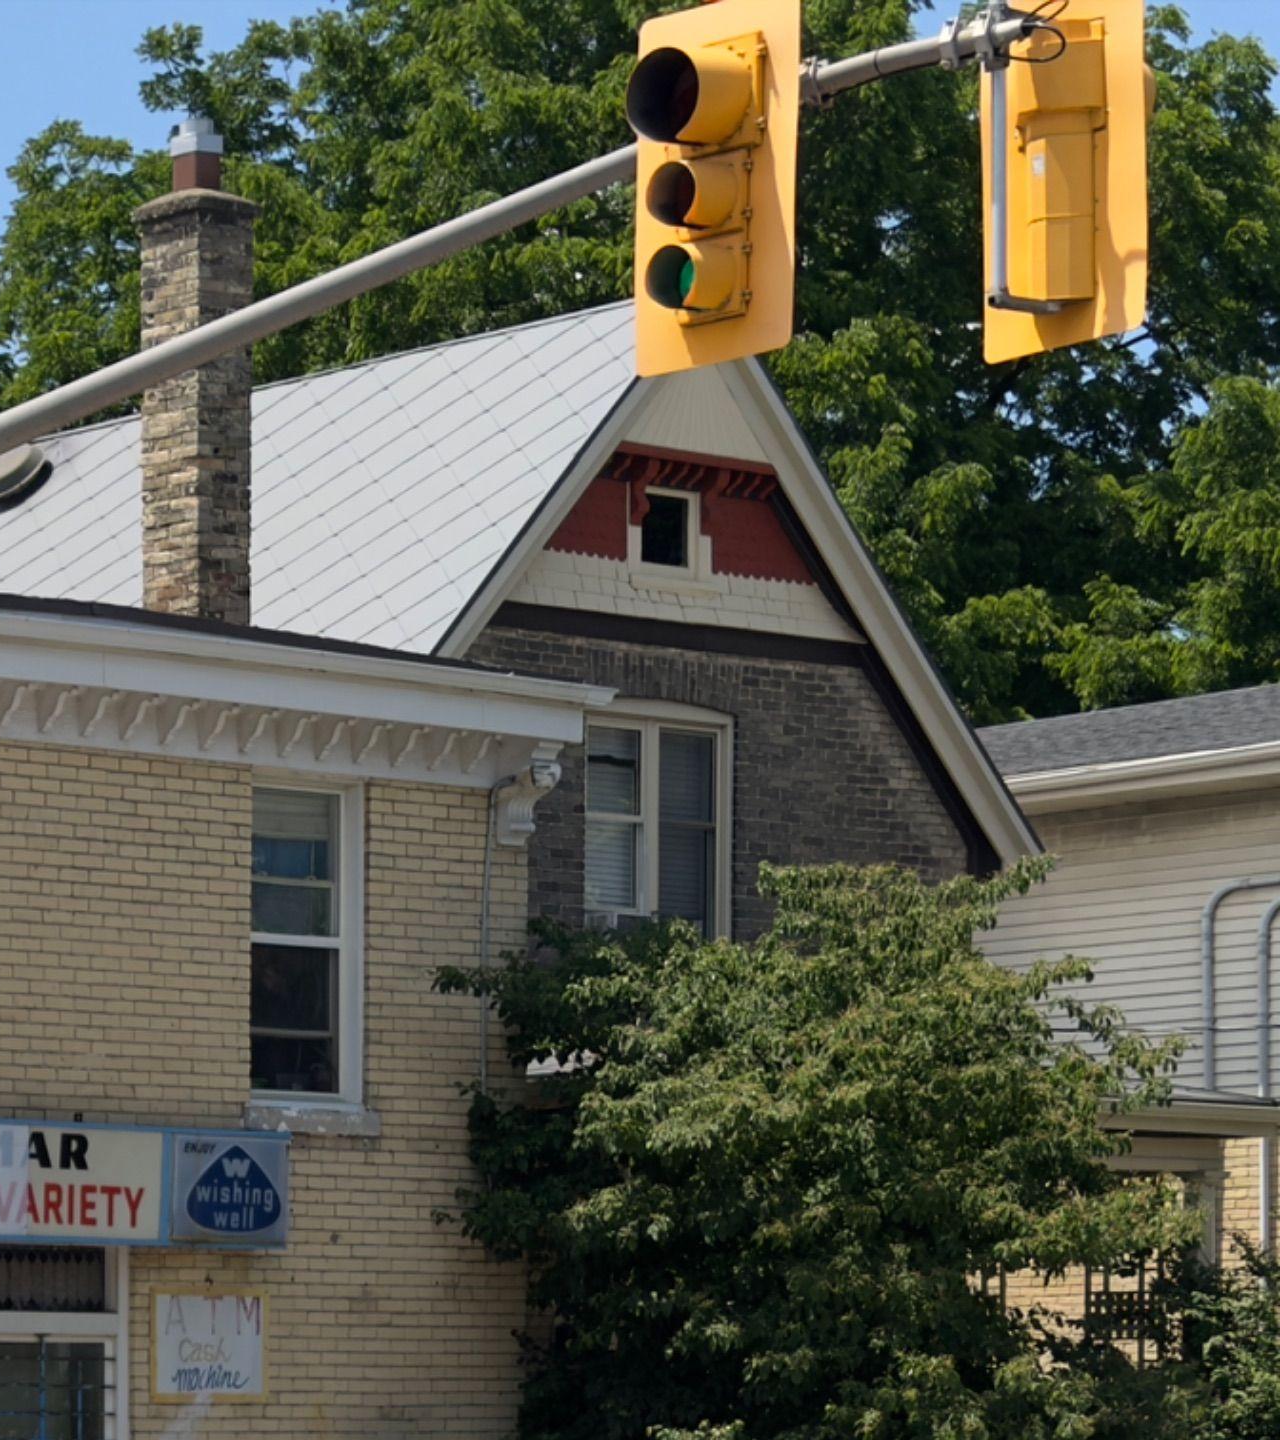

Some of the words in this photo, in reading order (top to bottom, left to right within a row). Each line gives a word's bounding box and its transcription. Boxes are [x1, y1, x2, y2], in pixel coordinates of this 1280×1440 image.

[184, 1143, 216, 1154] ENJOY
[195, 1179, 273, 1213] wishing
[213, 1206, 254, 1229] well
[165, 1295, 260, 1336] ATM
